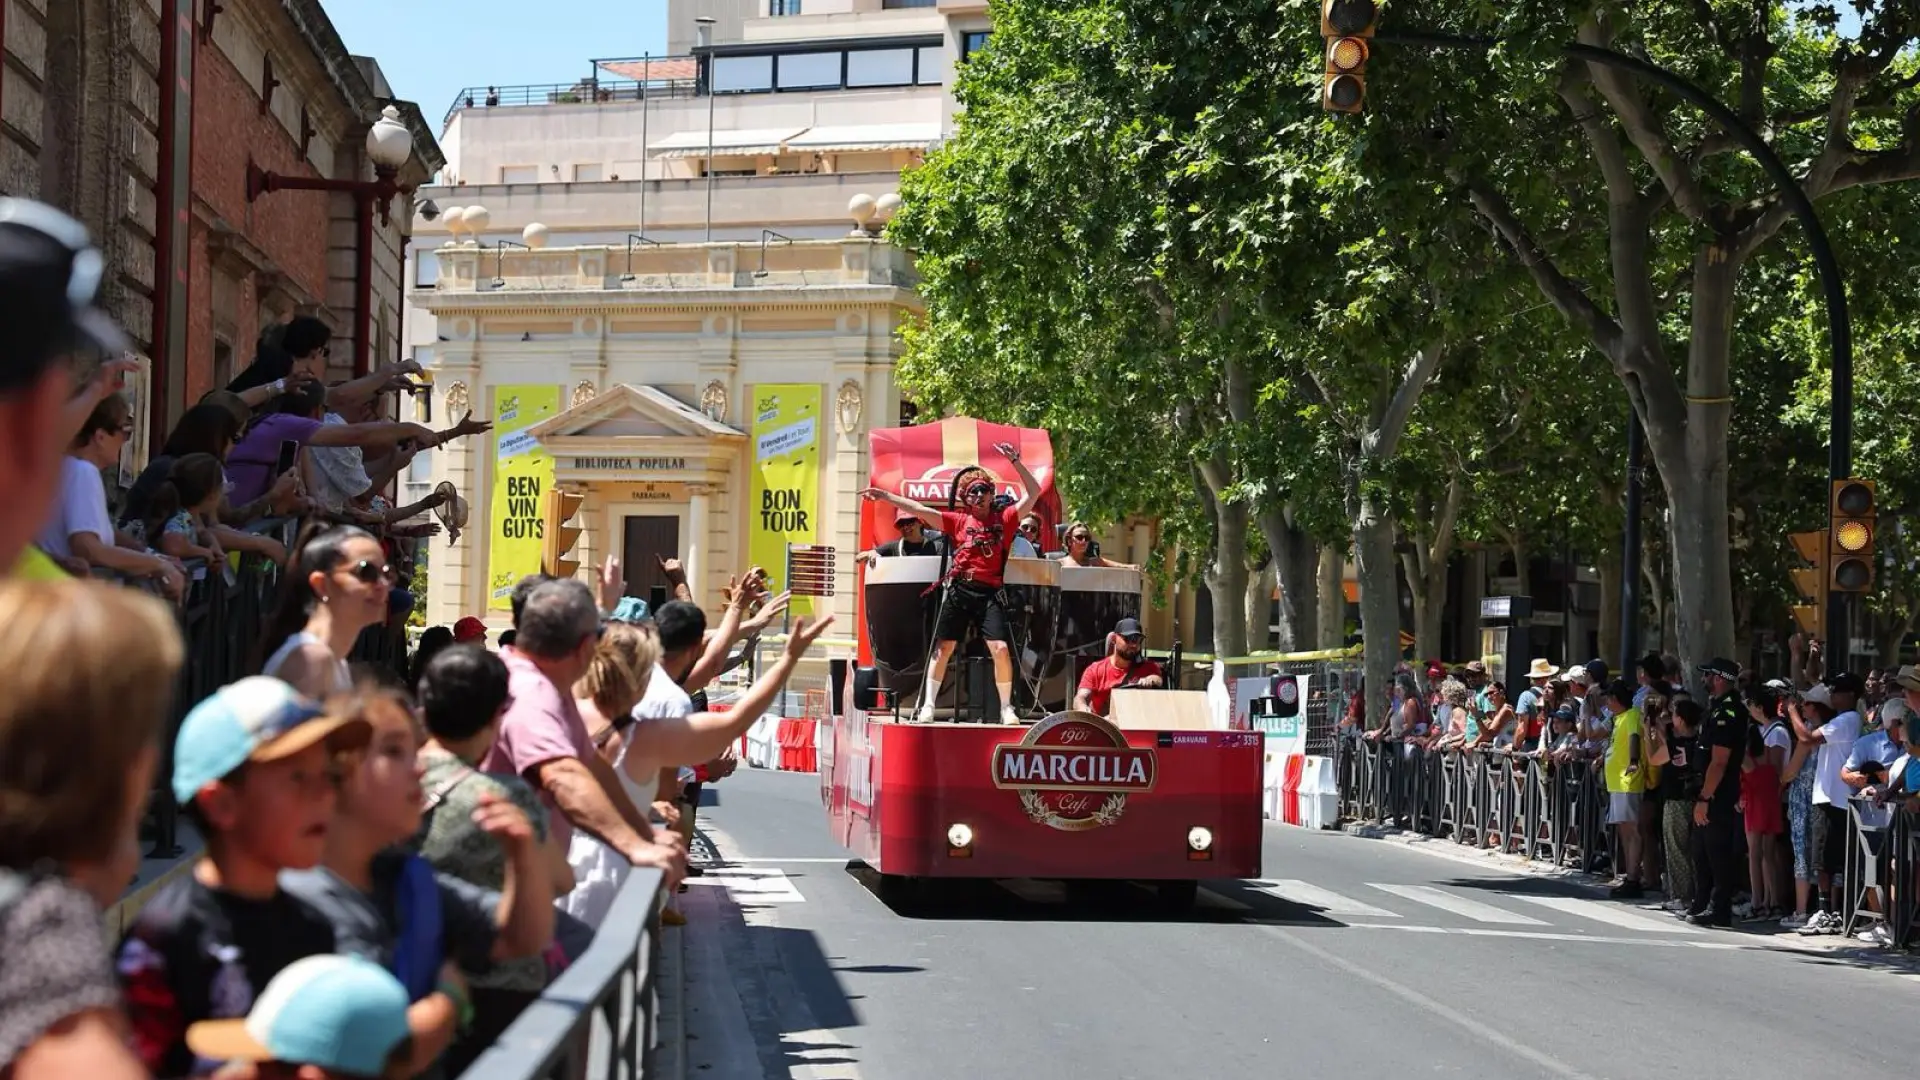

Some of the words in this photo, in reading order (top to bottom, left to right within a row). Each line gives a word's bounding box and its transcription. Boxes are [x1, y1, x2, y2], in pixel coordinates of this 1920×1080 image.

[575, 458, 632, 469] BIBLIOTECA
[639, 458, 685, 469] POPULAR
[507, 476, 540, 497] BEN
[508, 497, 536, 517] VIN
[762, 489, 801, 511] BON
[503, 518, 544, 539] GUTS
[761, 511, 809, 532] TOUR
[1173, 735, 1208, 744] CARAVANE
[1003, 753, 1147, 783] MARCILLA
